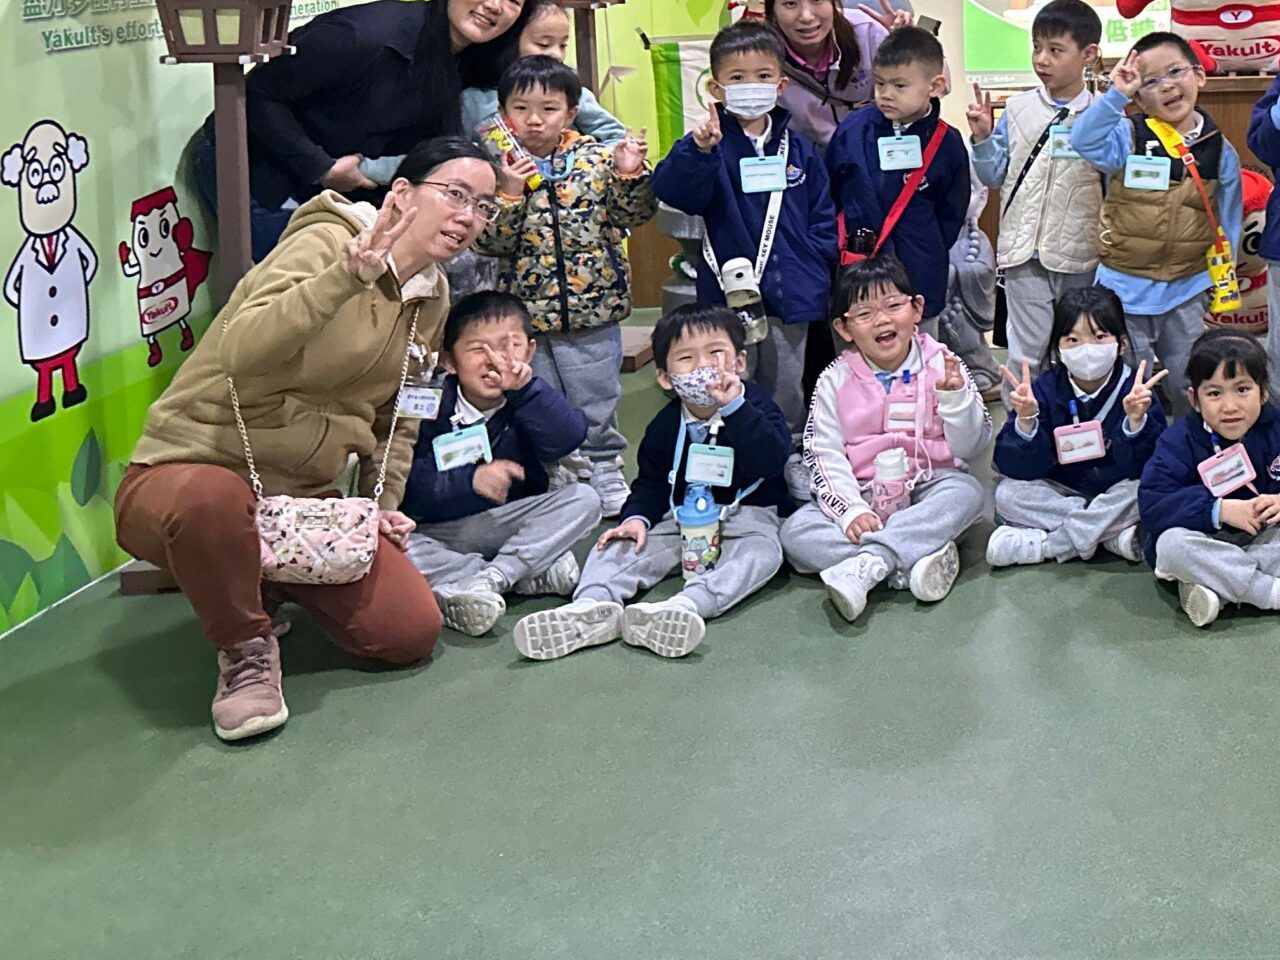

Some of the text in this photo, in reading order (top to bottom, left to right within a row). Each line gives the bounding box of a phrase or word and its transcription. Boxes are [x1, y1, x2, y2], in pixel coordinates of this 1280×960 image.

[1230, 11, 1241, 21] Y
[41, 25, 113, 51] Yakult's
[1200, 41, 1276, 58] Yakult
[764, 214, 776, 242] MOUSE
[146, 301, 174, 320] Yakult
[1210, 310, 1268, 324] Yakul
